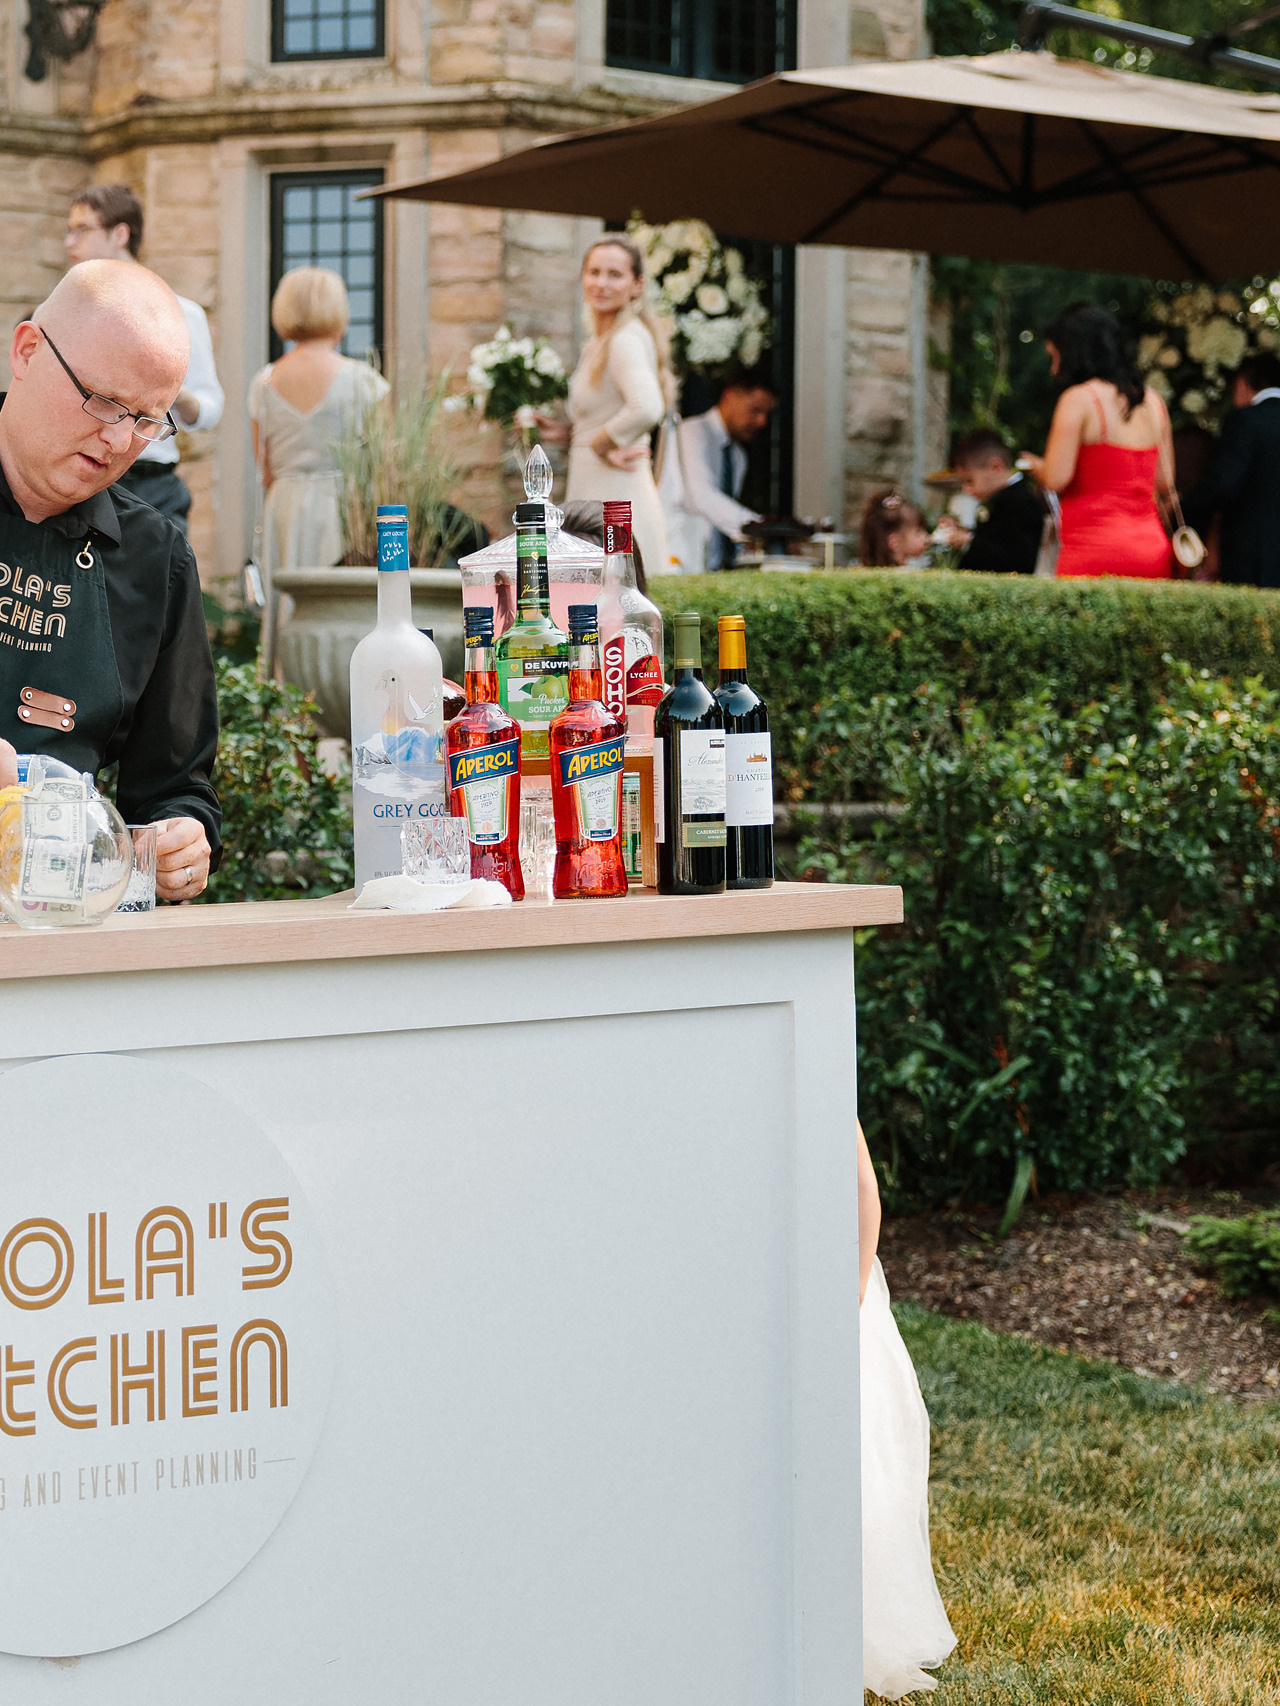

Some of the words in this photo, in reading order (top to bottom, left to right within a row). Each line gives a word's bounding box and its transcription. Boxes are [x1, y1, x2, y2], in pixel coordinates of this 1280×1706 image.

[16, 638, 52, 653] PLANNING
[524, 662, 540, 670] DE
[541, 660, 568, 669] KUYP
[630, 671, 658, 679] LYCHEE
[605, 646, 624, 717] SOHO
[456, 750, 513, 781] APEROL
[567, 746, 623, 779] APEROL
[373, 803, 413, 818] GREY
[418, 803, 445, 817] GOO
[23, 1473, 62, 1508] AND
[78, 1461, 141, 1501] EVENT
[156, 1447, 258, 1491] PLANNING
